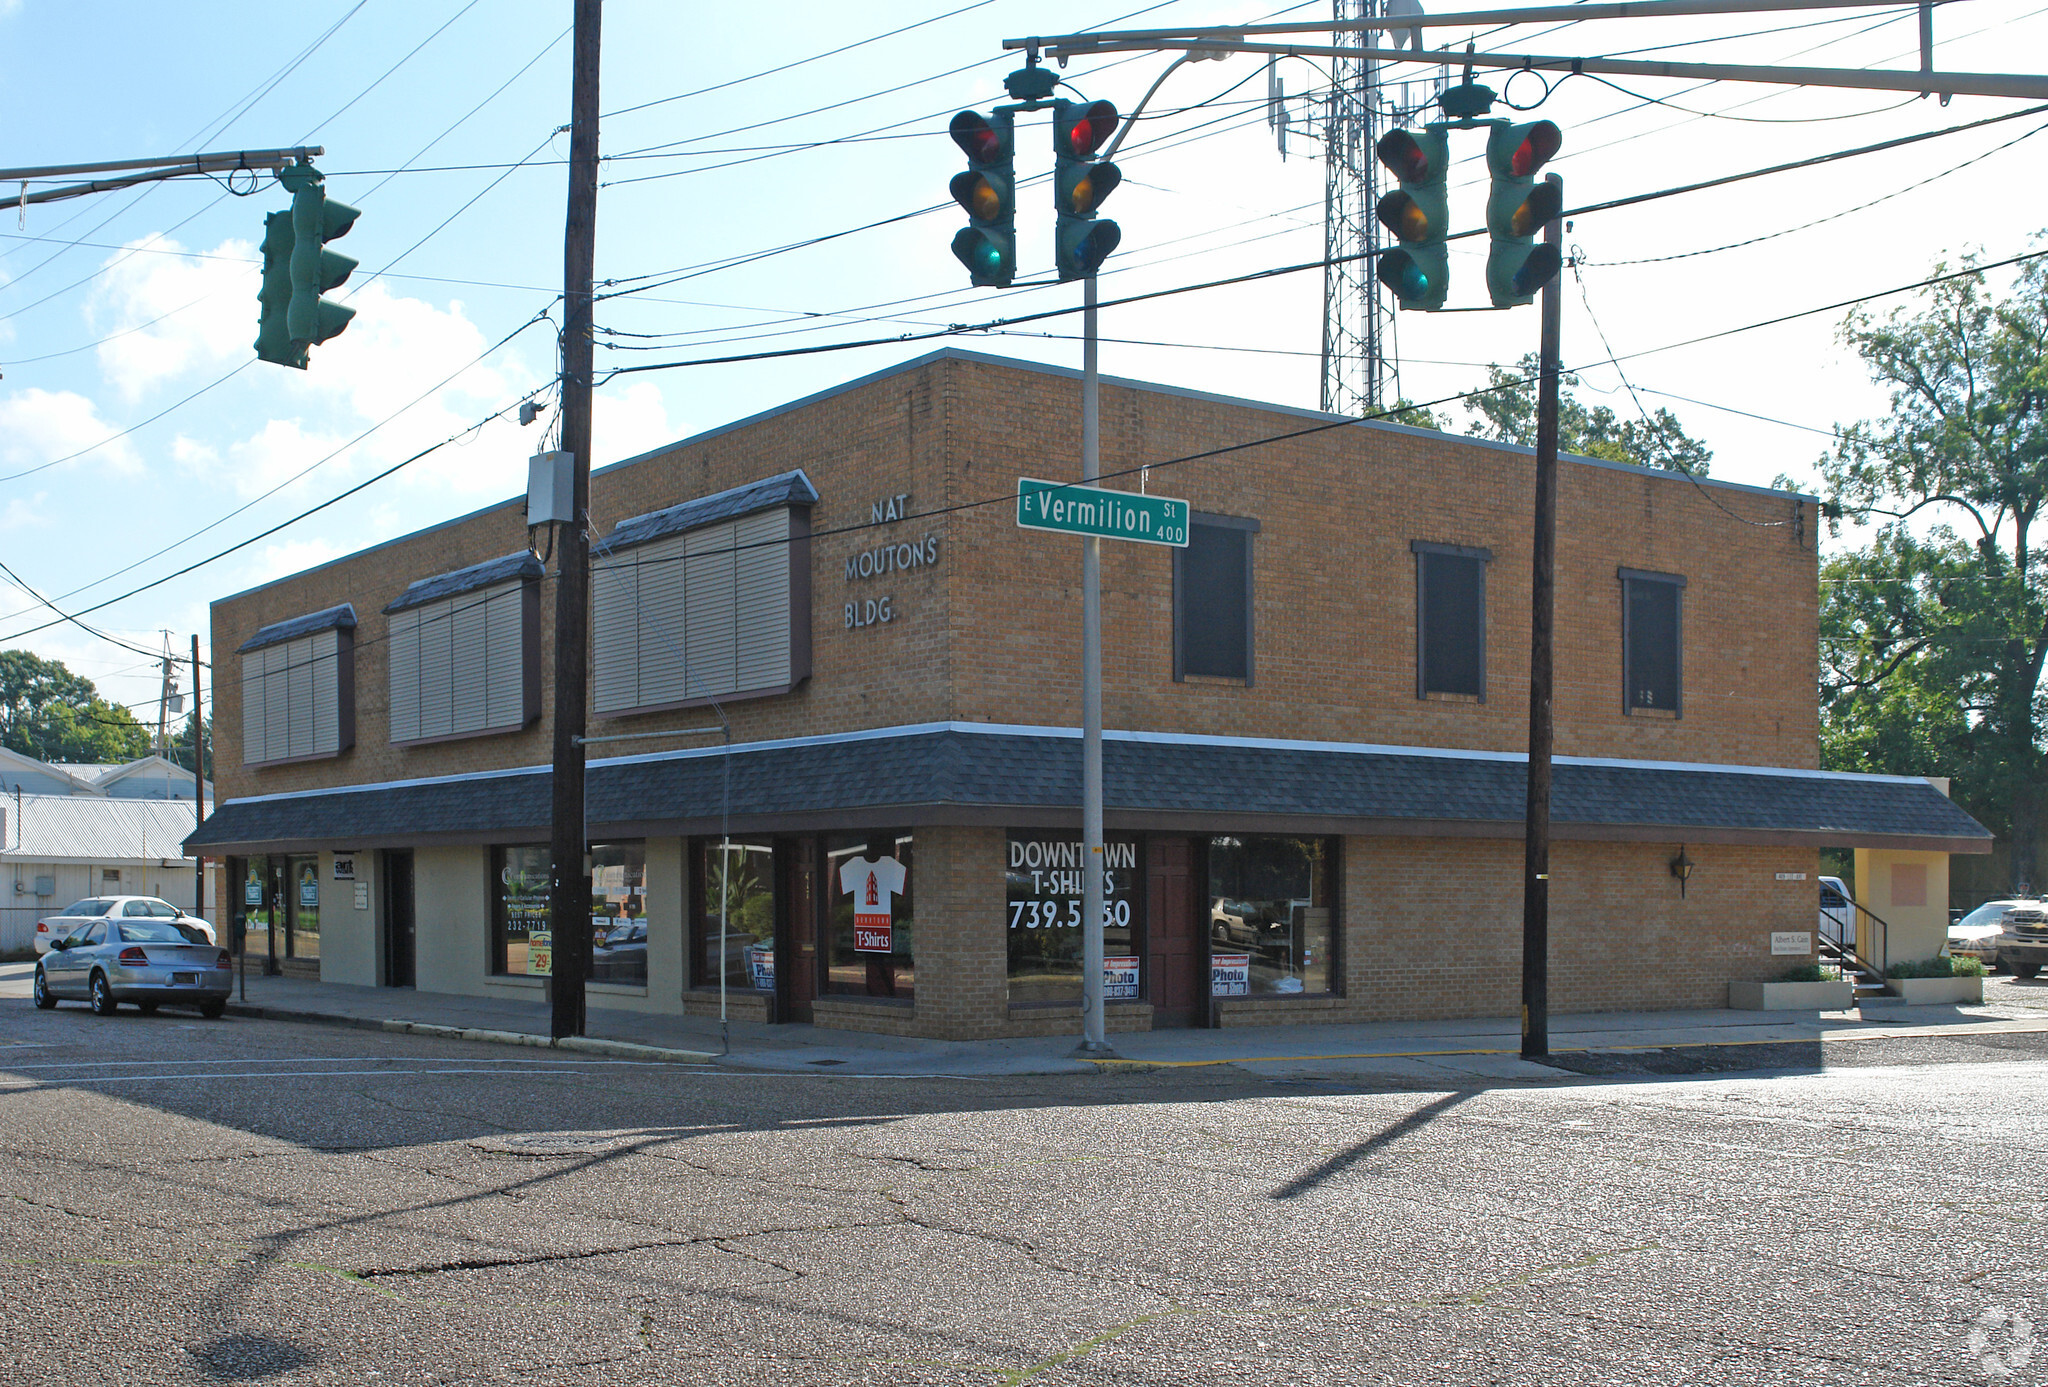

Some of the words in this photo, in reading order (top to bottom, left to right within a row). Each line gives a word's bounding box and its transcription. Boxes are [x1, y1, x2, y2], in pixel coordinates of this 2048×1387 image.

[872, 494, 907, 524] NAT
[1025, 496, 1031, 511] E
[1039, 491, 1150, 533] Vermilion
[1163, 503, 1176, 519] St
[1157, 525, 1183, 542] 400
[845, 532, 937, 582] MOUTON'S
[845, 596, 897, 628] BLDG.
[1010, 841, 1136, 868] DOWNTWN
[1031, 870, 1115, 895] T-SHIS
[507, 920, 546, 931] 232-7719
[1009, 900, 1131, 929] 739.550
[856, 931, 889, 948] T-Shirts
[1103, 970, 1135, 984] Photo
[1212, 968, 1244, 981] Photo
